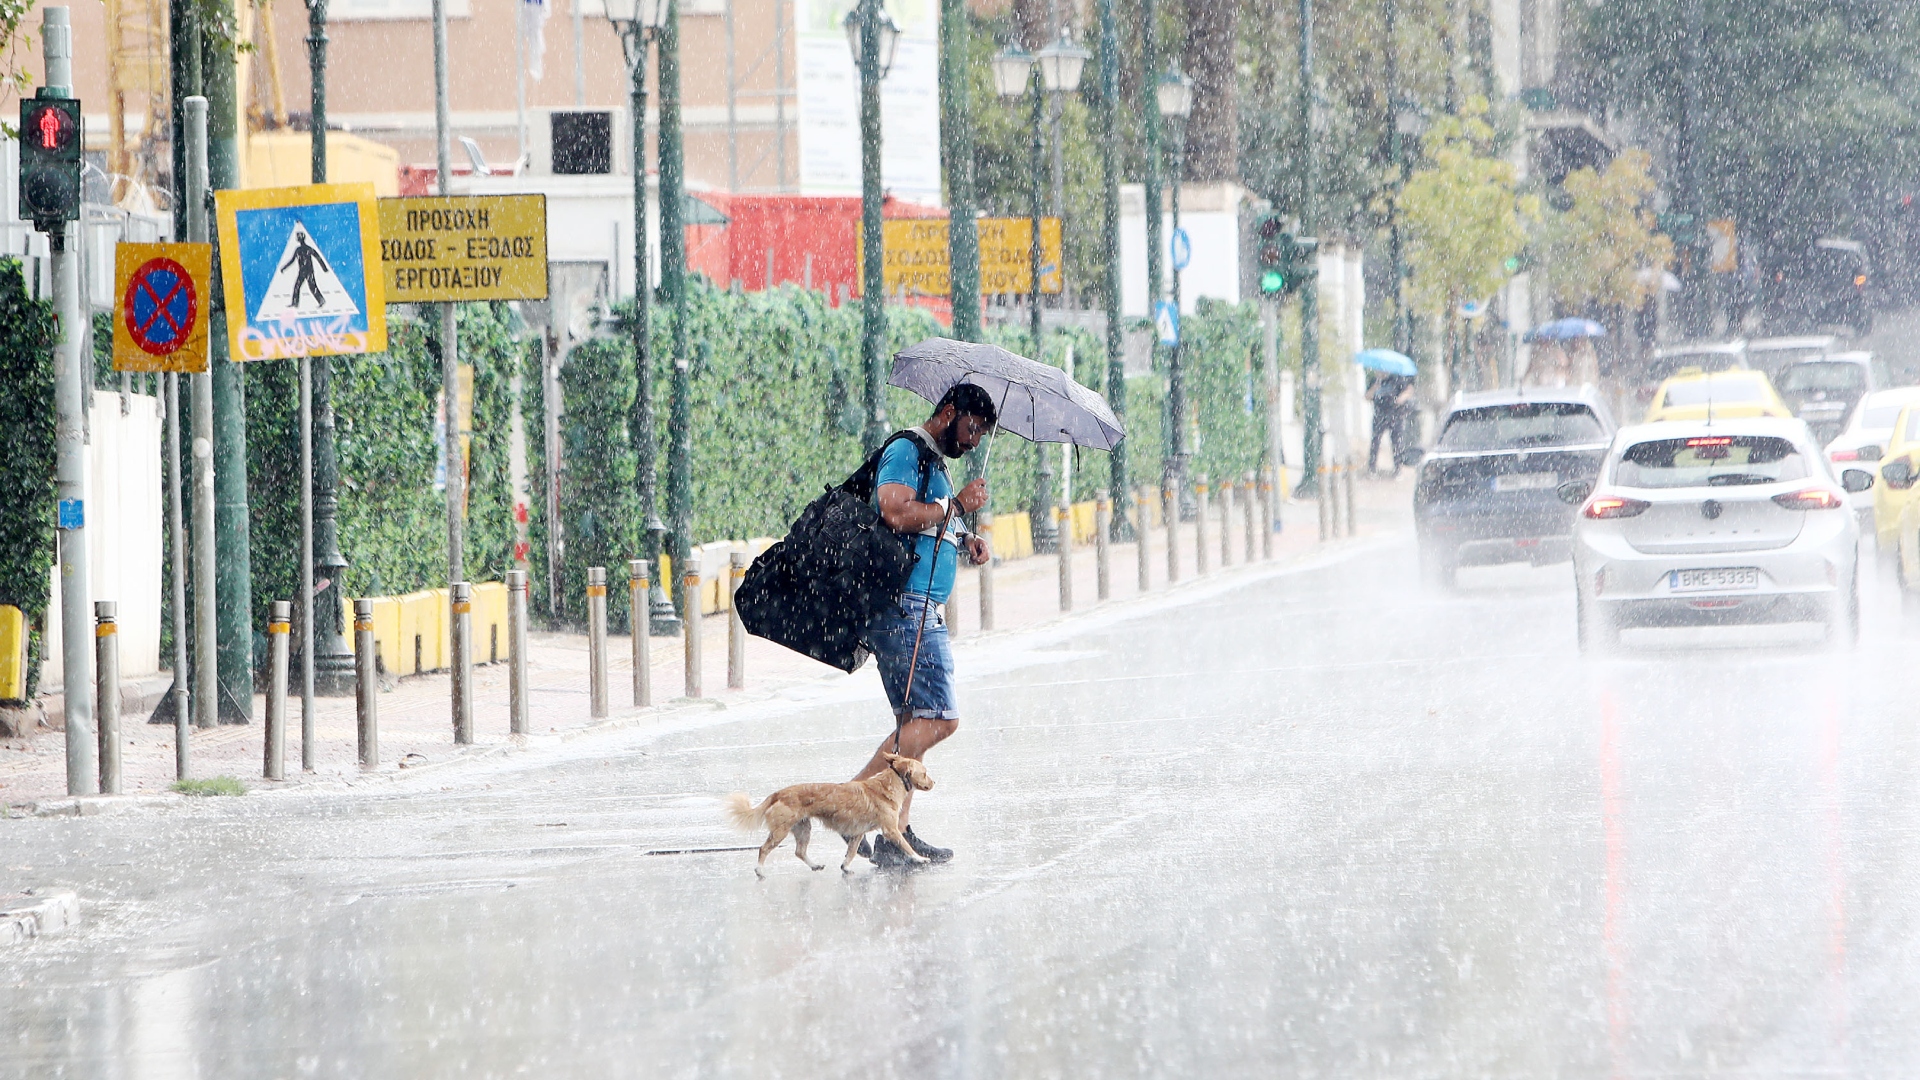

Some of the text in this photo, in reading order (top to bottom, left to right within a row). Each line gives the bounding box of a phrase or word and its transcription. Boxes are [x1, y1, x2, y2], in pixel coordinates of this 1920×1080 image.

[407, 209, 490, 231] ΠΡΟΣΟΧΗ
[912, 223, 1005, 241] ΠΡΟΧΗ
[381, 239, 436, 261] ΣΟΔΟΣ
[467, 236, 535, 259] ΕΞΟΔΟΣ
[886, 248, 949, 266] ΣΟΔΟΣ
[396, 267, 502, 289] ΕΡΓΟΤΑΞΙΟΥ
